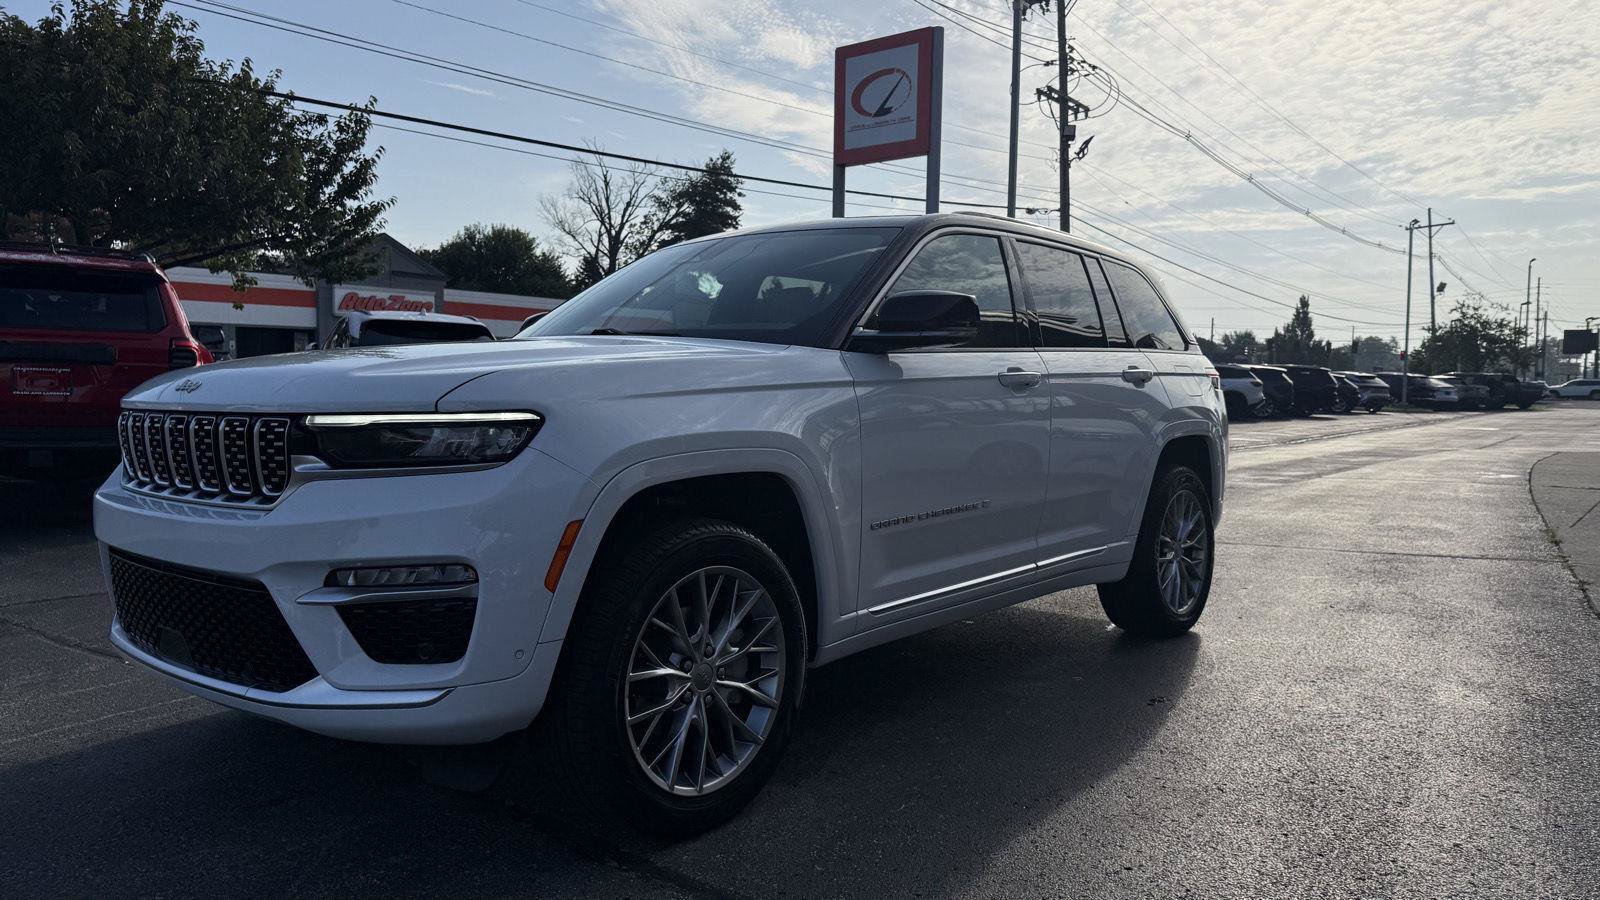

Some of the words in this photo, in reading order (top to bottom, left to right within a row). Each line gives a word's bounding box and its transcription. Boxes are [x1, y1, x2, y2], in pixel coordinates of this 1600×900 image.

[338, 292, 434, 312] AutoZone
[870, 514, 916, 531] GRAND
[917, 499, 992, 521] CHEROKEE
